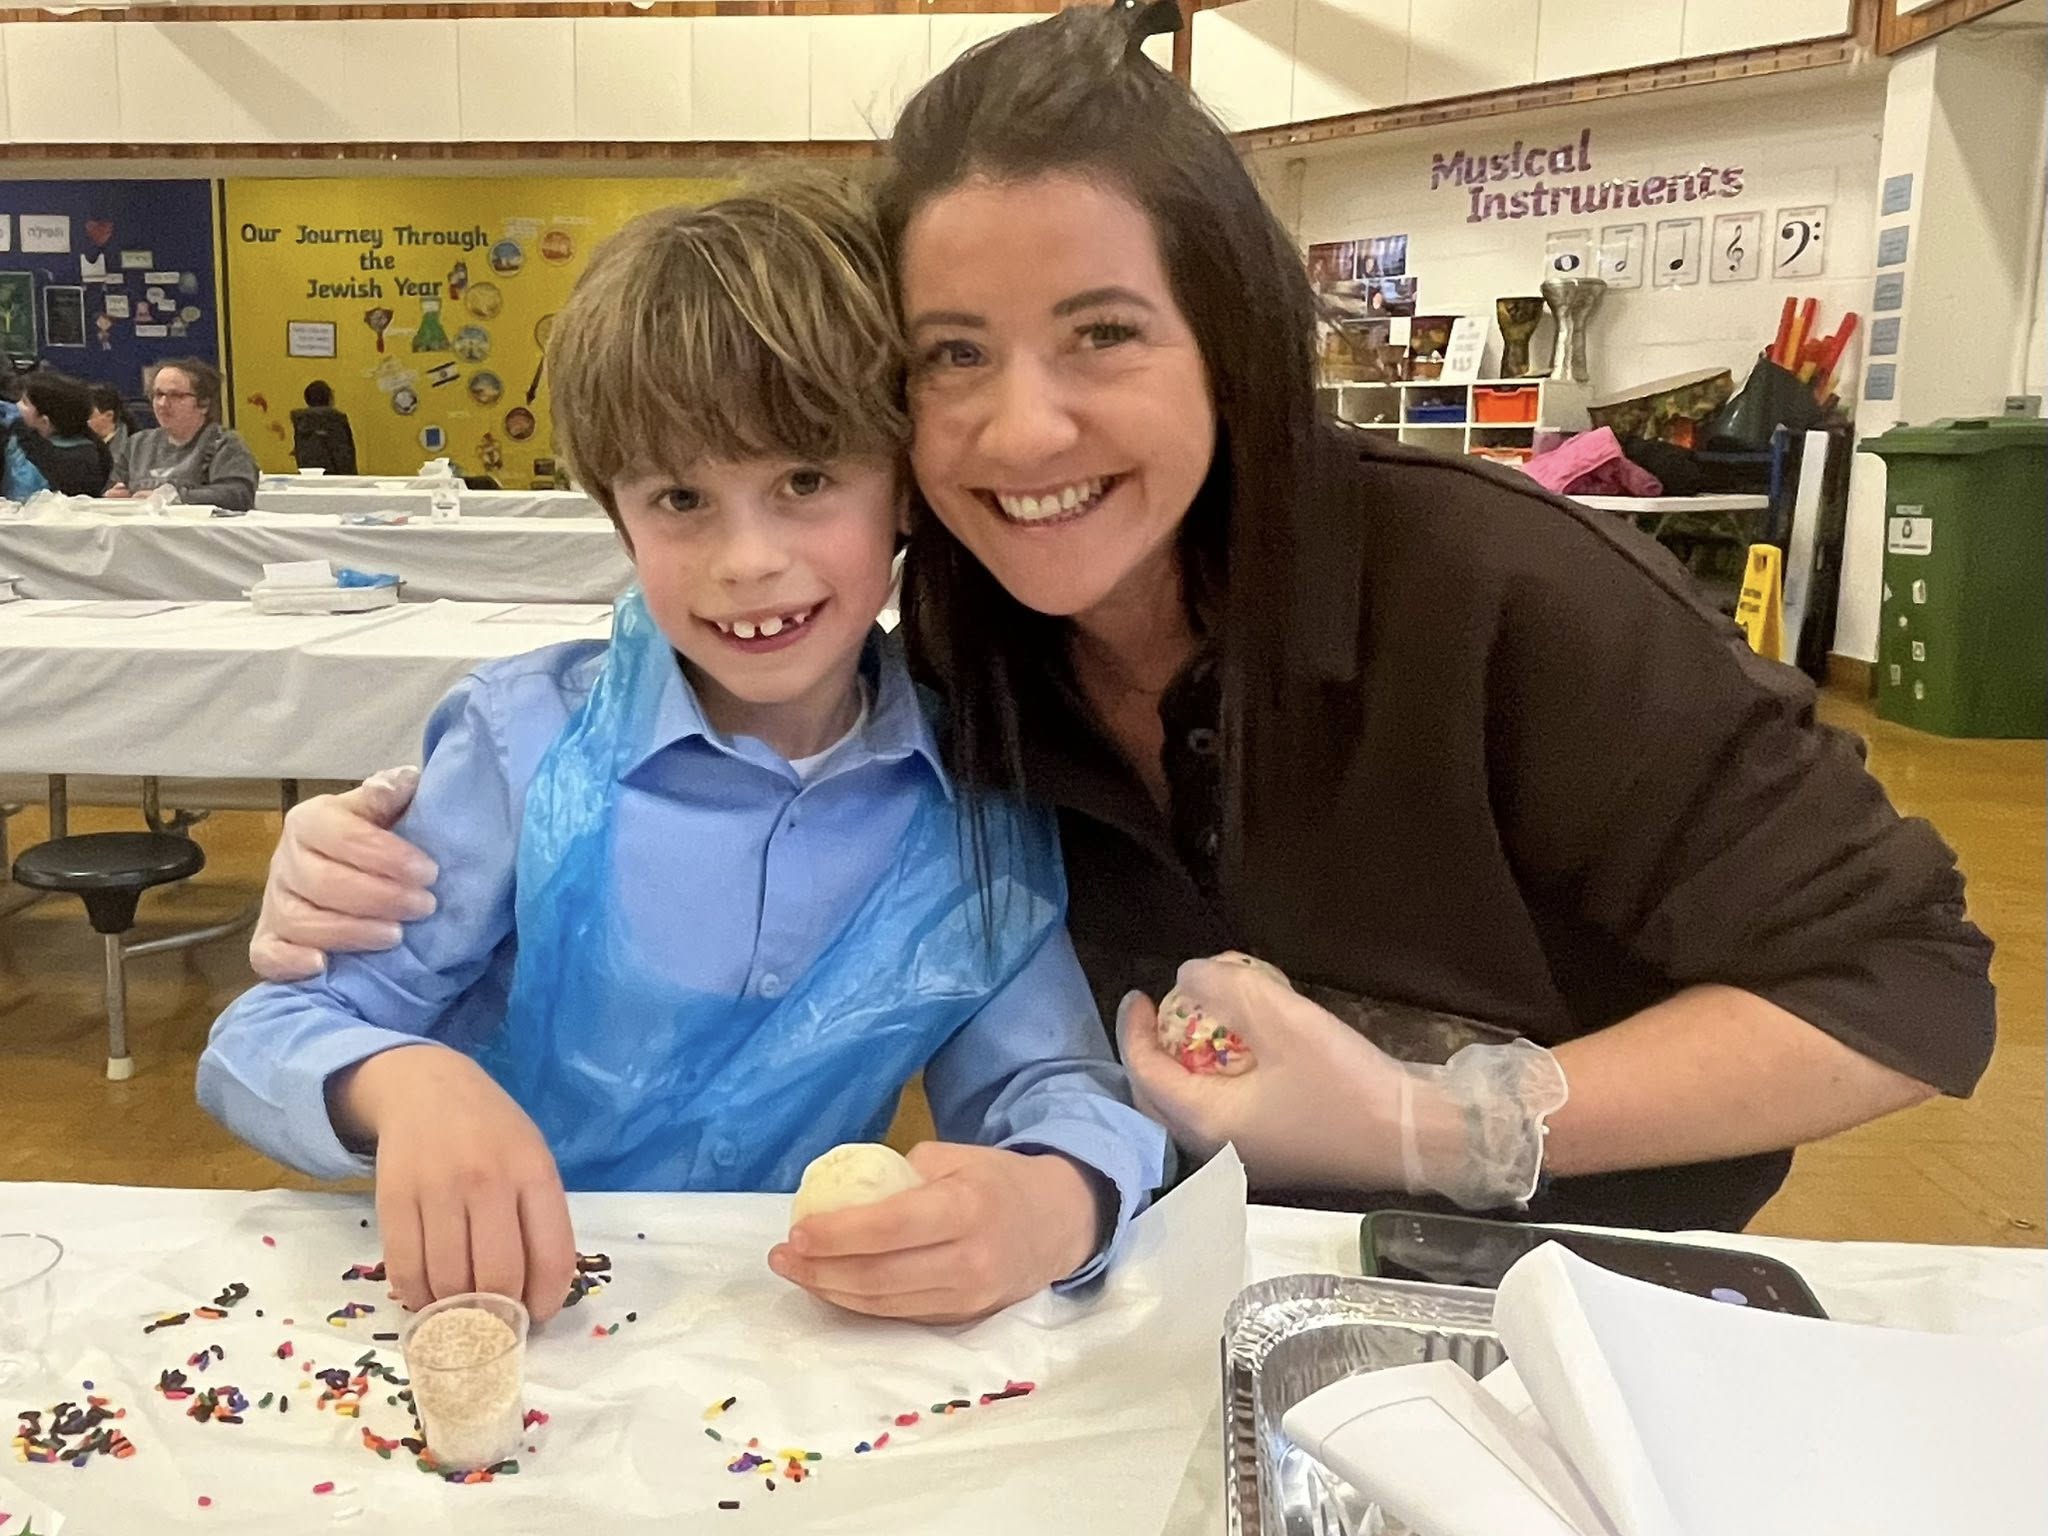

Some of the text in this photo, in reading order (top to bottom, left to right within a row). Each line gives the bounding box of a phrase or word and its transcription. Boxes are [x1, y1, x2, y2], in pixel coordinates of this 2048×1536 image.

[1431, 128, 1591, 190] Musical
[1466, 163, 1744, 223] Instruments
[241, 223, 282, 243] Our
[296, 225, 383, 249] Journey
[393, 224, 489, 251] Through
[360, 250, 395, 271] the
[306, 276, 443, 299] Jewish Year
